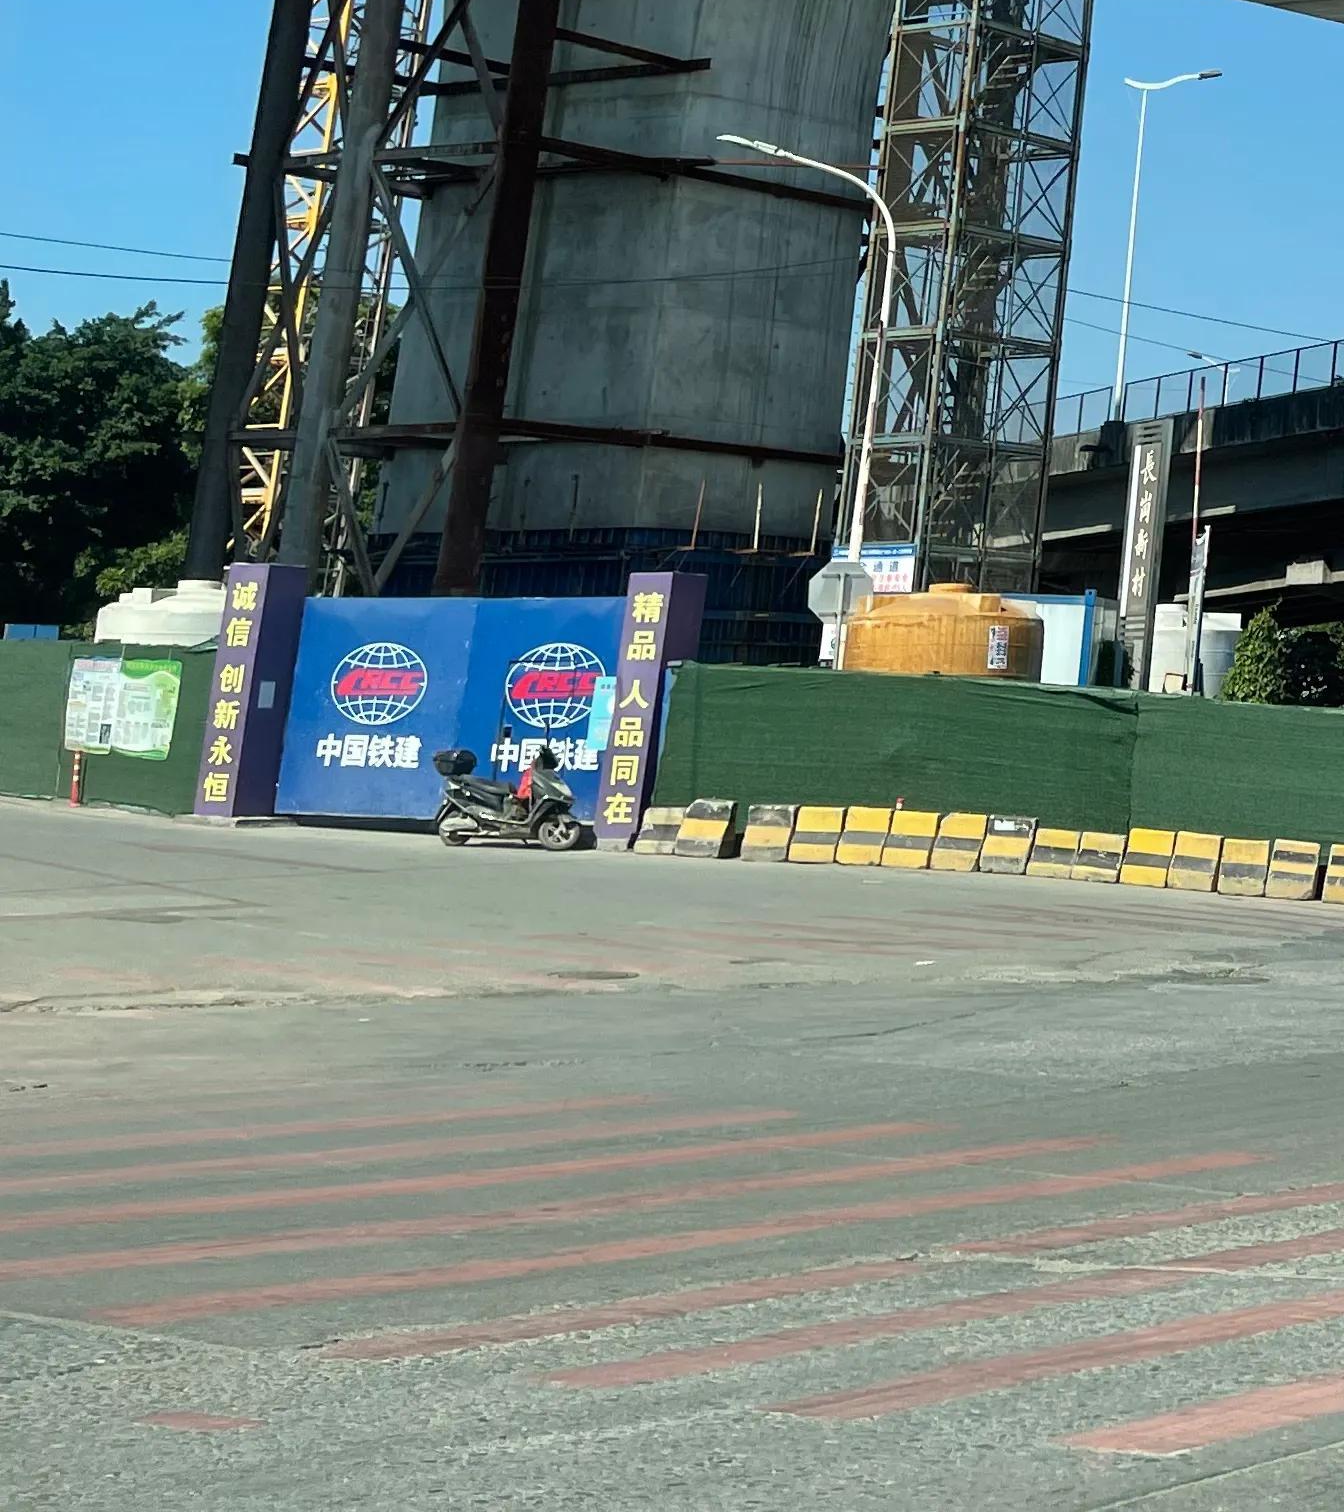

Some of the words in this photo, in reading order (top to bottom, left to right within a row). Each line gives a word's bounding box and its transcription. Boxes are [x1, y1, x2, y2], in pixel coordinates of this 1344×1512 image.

[334, 667, 425, 697] CRCC
[315, 732, 423, 770] 中国铁建
